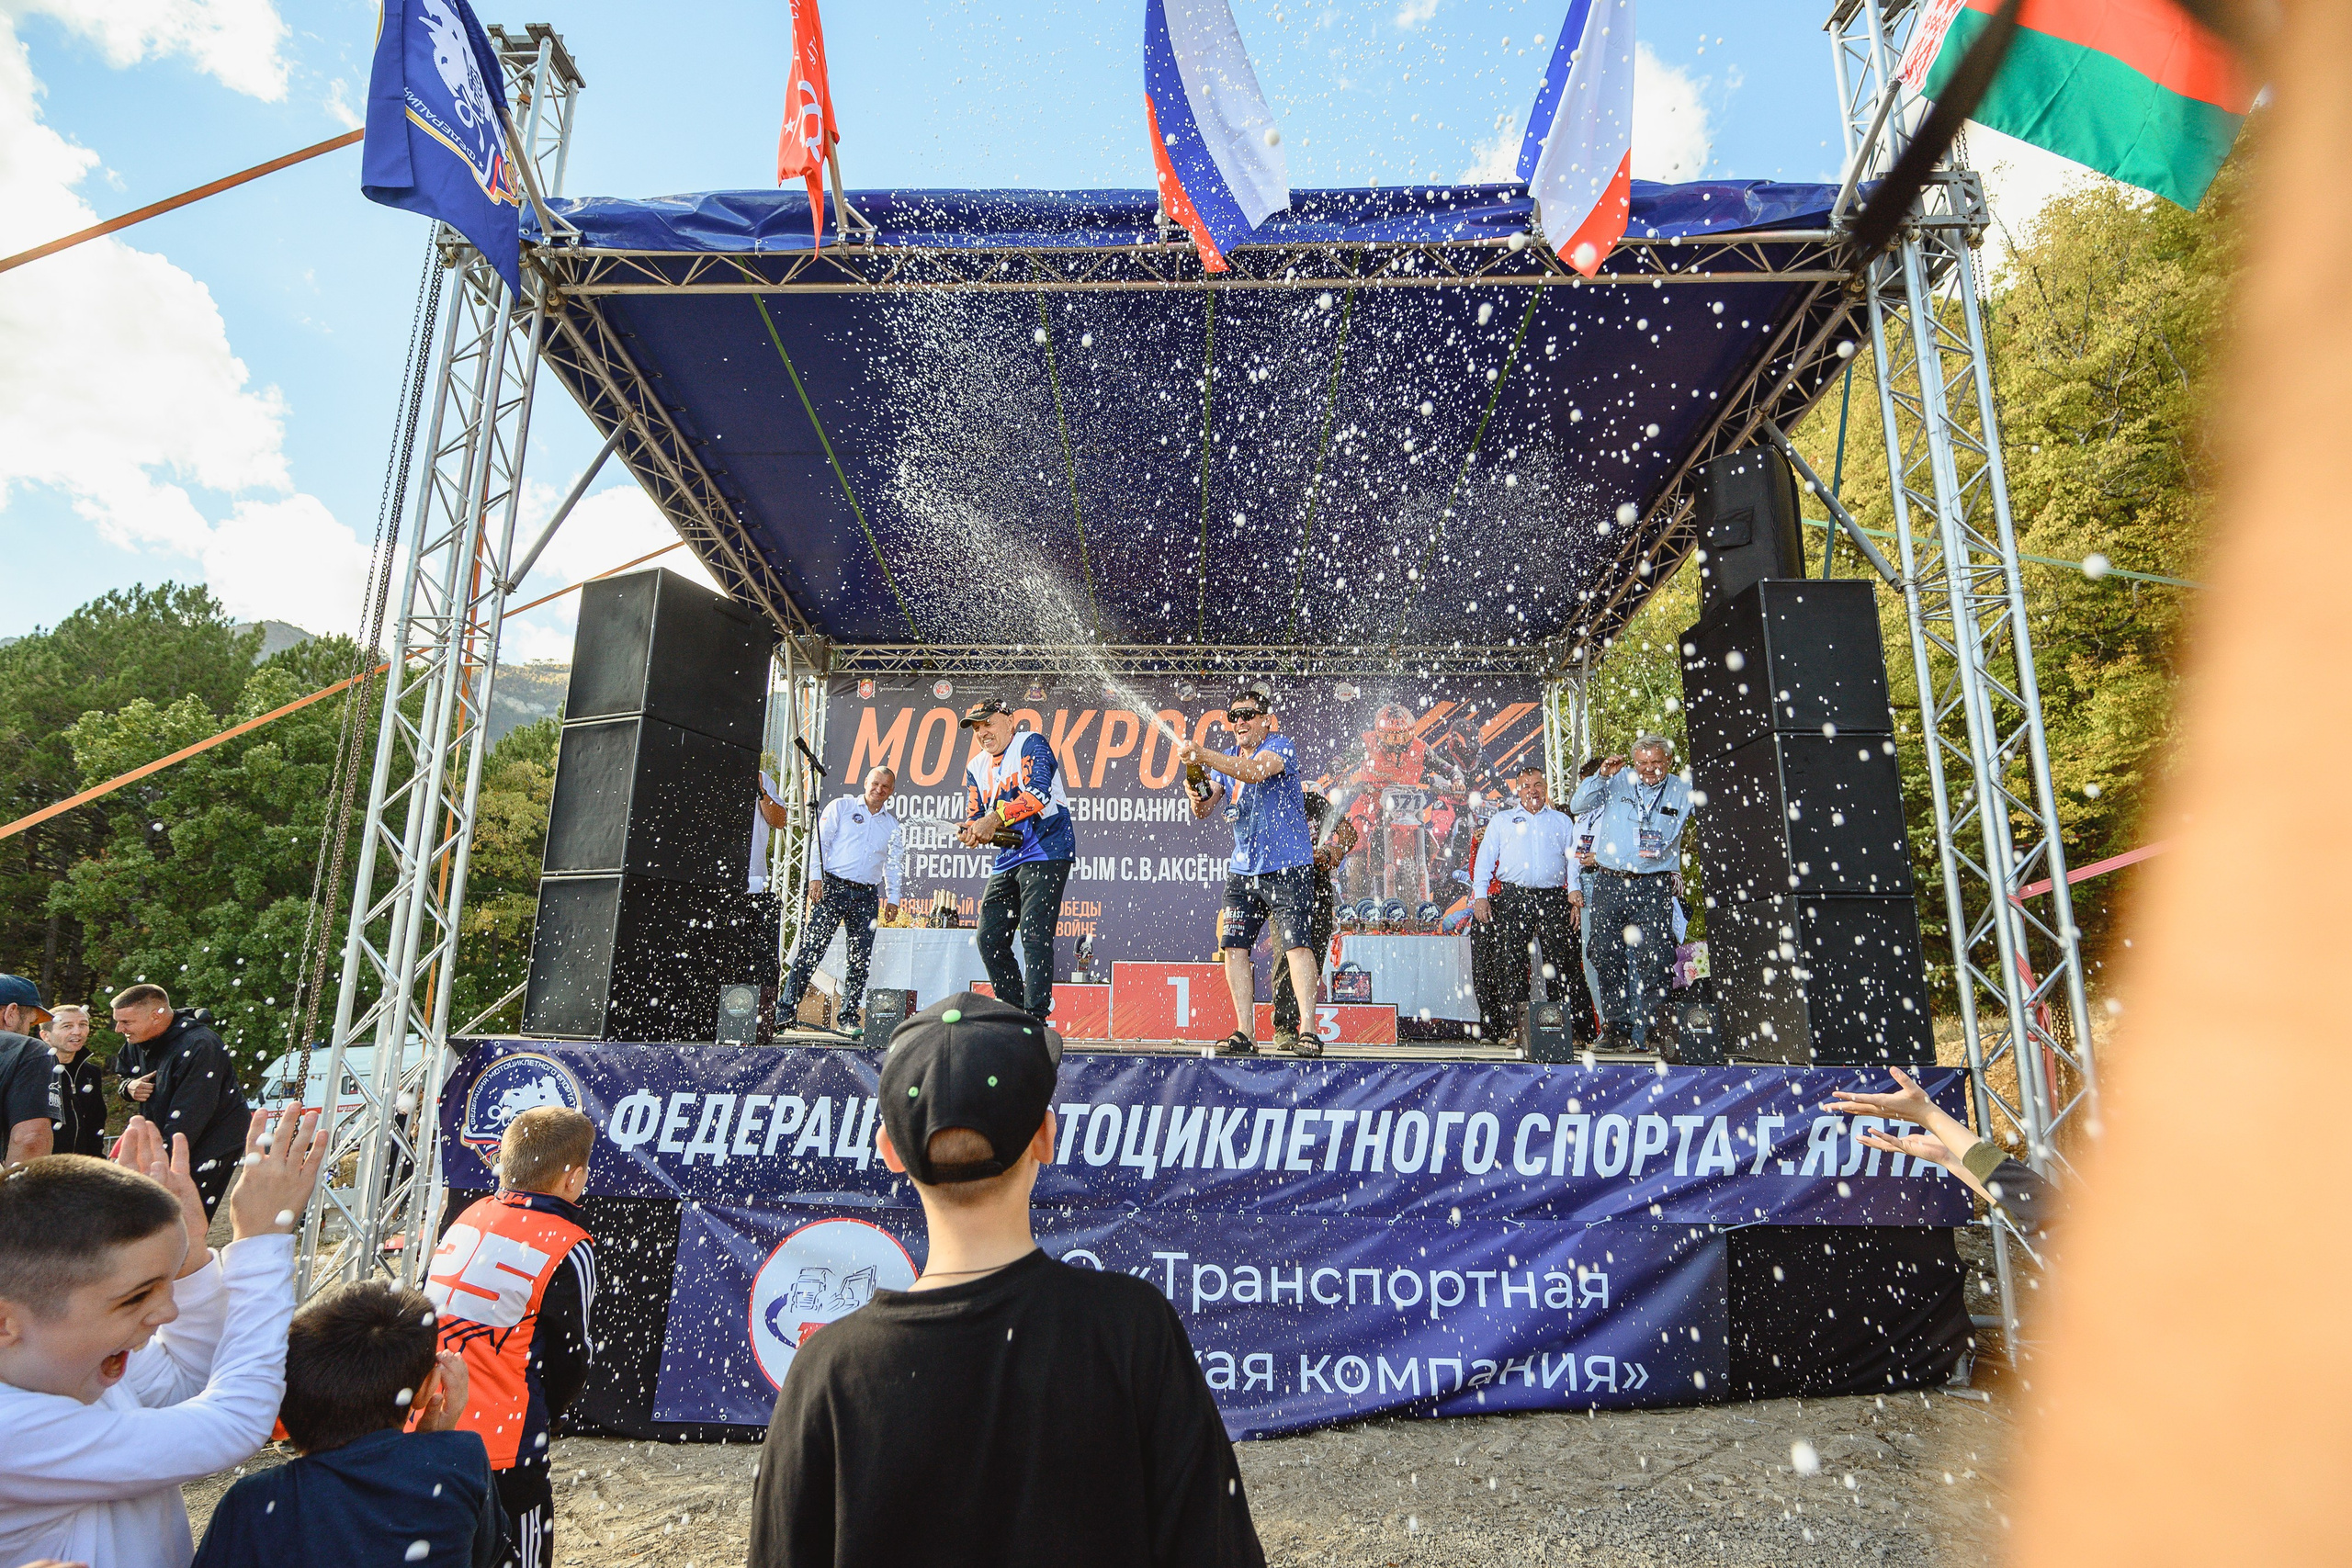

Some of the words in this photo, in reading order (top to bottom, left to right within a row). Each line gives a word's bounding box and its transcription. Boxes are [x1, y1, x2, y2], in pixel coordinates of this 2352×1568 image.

[1068, 796, 1191, 822] ЕВНОВАНИЯ
[915, 853, 993, 879] РЕСПУБ
[1068, 855, 1115, 881] РЫМ
[1058, 900, 1102, 918] БЕДЫ
[1056, 919, 1097, 937] ВОЙНЕ
[1167, 976, 1189, 1027] 1
[1319, 1007, 1341, 1042] 3
[469, 1077, 491, 1125] ФЕДЕРАЦИЯ
[488, 1059, 557, 1080] МОТОЦИКЛЕТНОГО
[608, 1089, 888, 1171] ФЕДЕРАЦ
[1047, 1102, 1501, 1180] ТОЦИКЛЕТНОГО
[1512, 1112, 1736, 1178] СПОРТА
